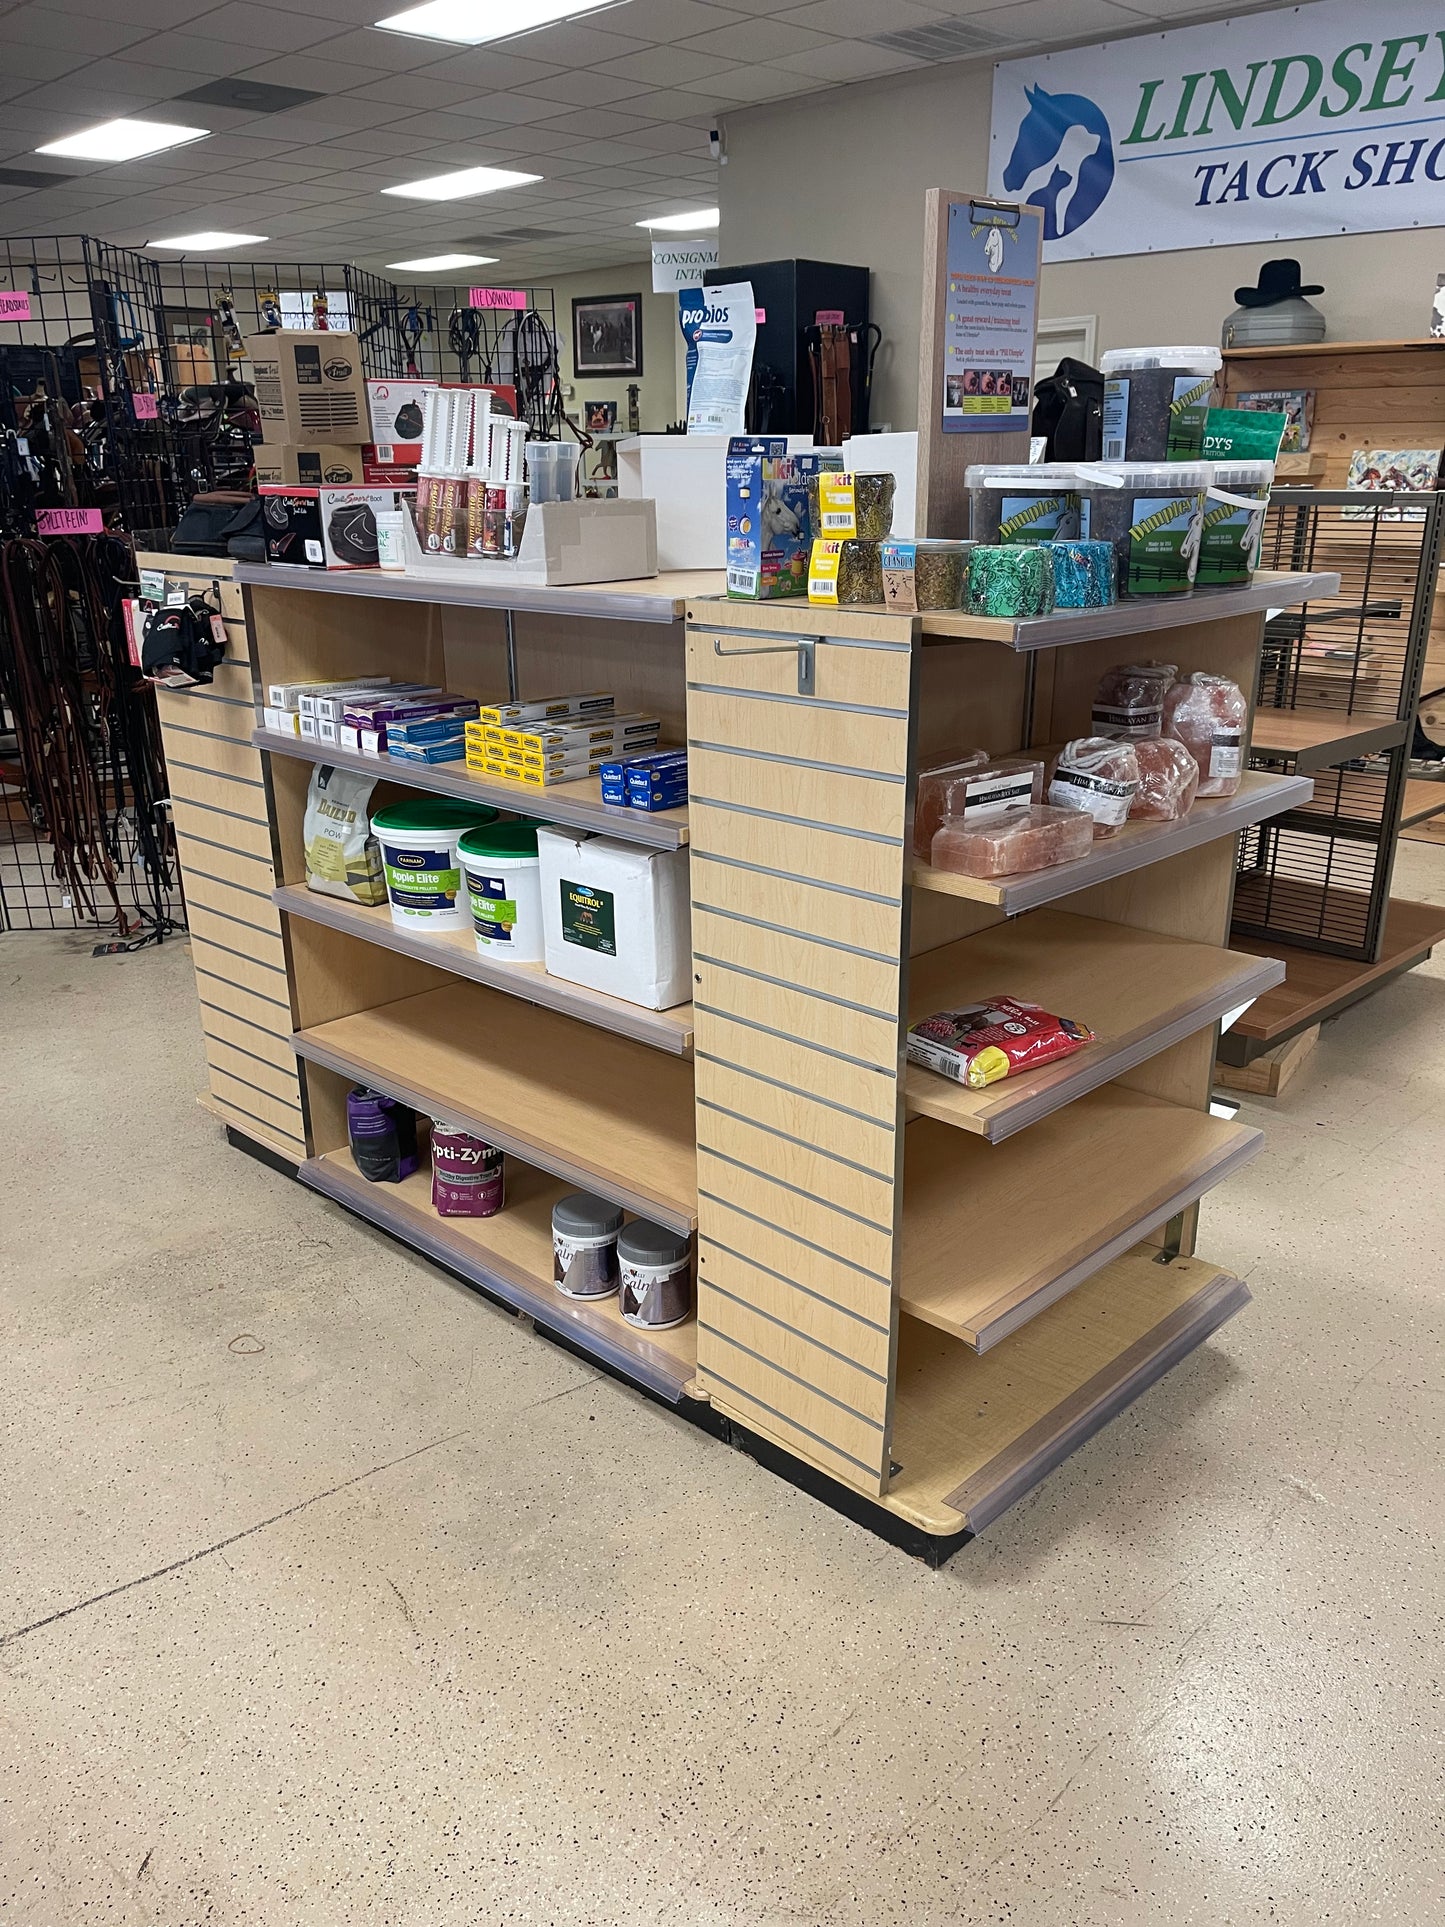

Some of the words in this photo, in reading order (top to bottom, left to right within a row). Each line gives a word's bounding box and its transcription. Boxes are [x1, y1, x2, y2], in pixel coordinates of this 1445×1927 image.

[1194, 150, 1338, 206] TACK
[471, 289, 485, 306] TIE
[485, 289, 513, 307] DOWNS
[682, 304, 729, 328] probios
[1273, 391, 1292, 400] FARM
[369, 494, 383, 502] Boot
[392, 870, 415, 884] Apple
[416, 873, 440, 884] Elite
[478, 900, 496, 912] Elite
[455, 1171, 479, 1181] Digestive
